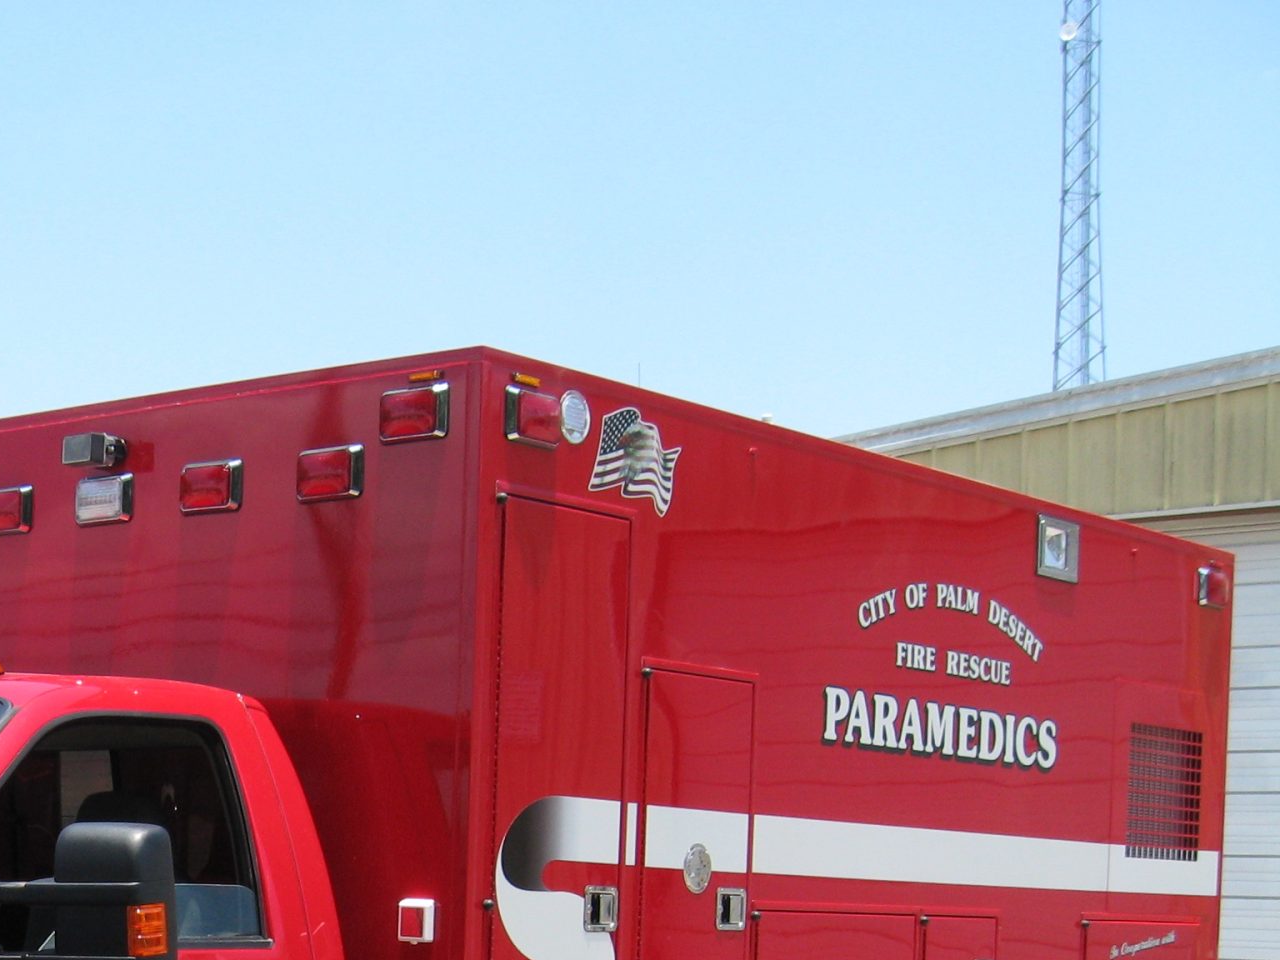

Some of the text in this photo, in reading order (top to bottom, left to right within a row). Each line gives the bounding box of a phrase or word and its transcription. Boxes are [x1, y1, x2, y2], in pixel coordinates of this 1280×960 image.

[857, 583, 1044, 662] CITY OF PALM DESERT
[896, 641, 1011, 685] FIRE RESCUE
[822, 685, 1058, 772] PARAMEDICS
